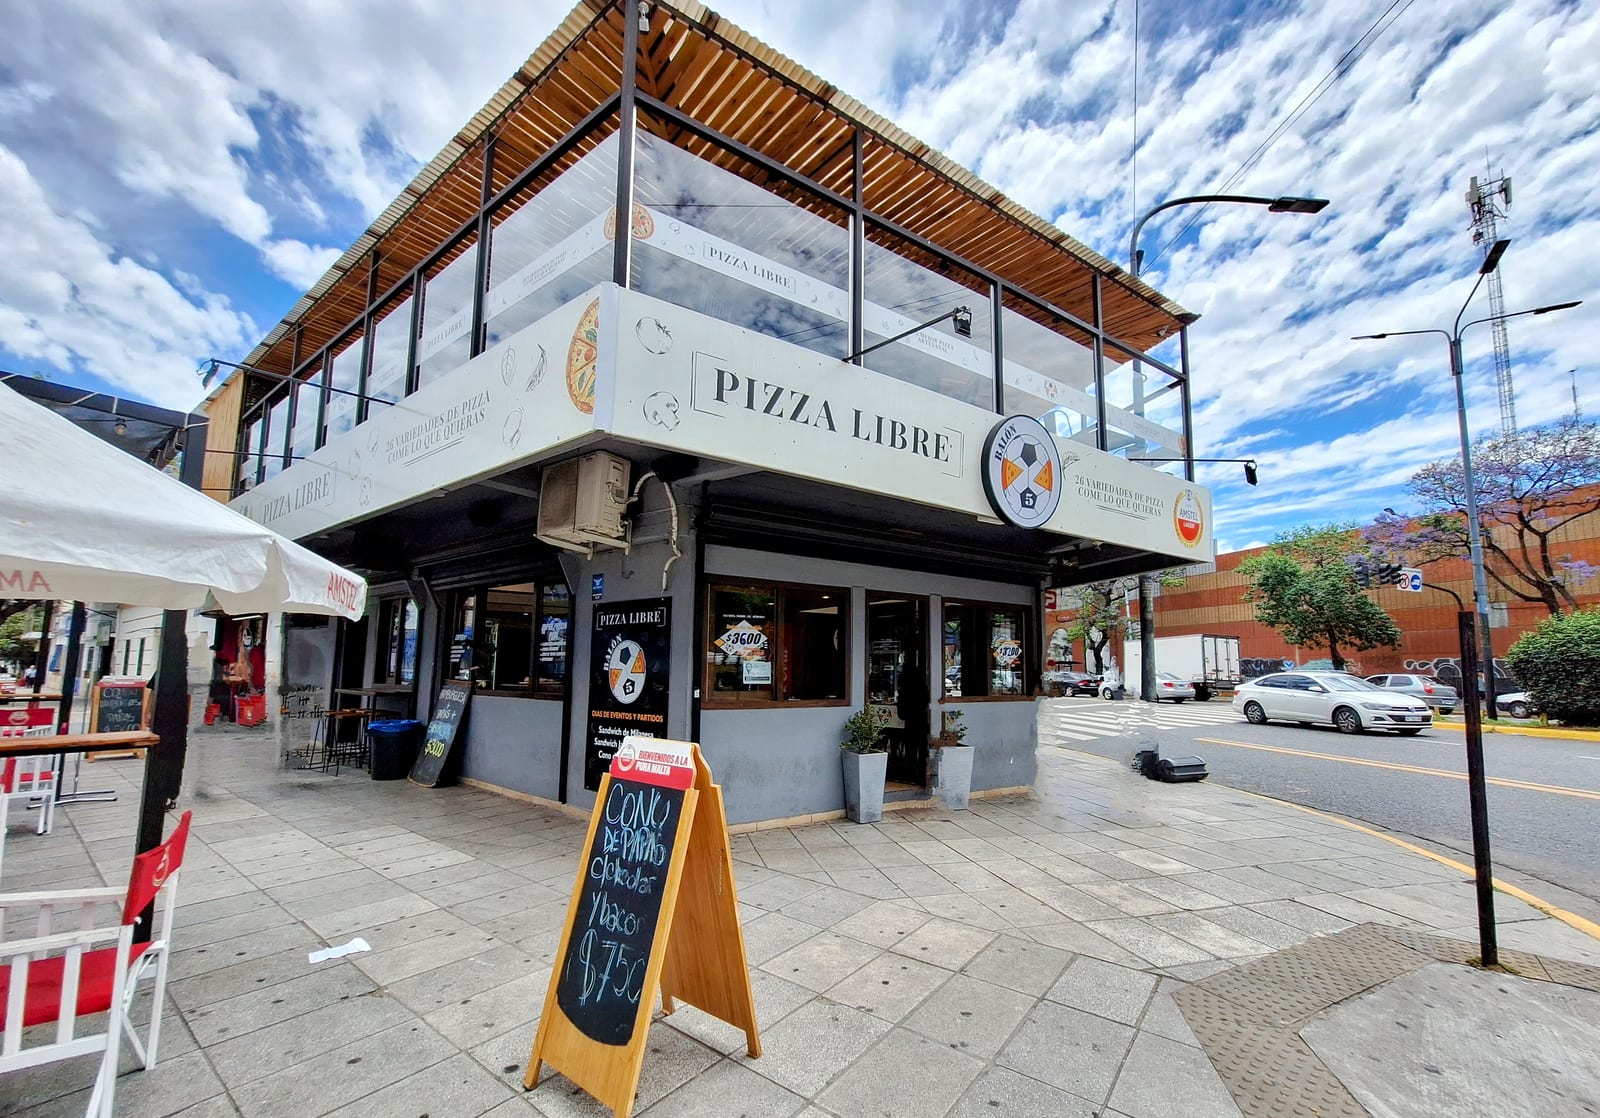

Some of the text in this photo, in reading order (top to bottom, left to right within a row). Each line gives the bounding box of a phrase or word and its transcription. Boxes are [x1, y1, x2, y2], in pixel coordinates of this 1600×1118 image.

[709, 247, 791, 288] PIZZA LIBRE
[395, 413, 445, 446] VARIEDADES
[447, 405, 460, 422] DE
[462, 389, 490, 415] PIZZA
[713, 367, 950, 463] PIZZA LIBRE
[387, 408, 486, 464] COME LO QUE QUIERAS
[994, 423, 1017, 461] BALÓN
[262, 473, 331, 524] PIZZA LIBRE
[1025, 493, 1034, 506] 5
[1075, 474, 1164, 508] 26 VARIEDADES DE PIZZA
[1078, 486, 1162, 517] COME LO QUE QUIERAS
[1179, 507, 1199, 522] AMSTEL
[327, 571, 357, 611] AMSTEL
[600, 610, 661, 626] PIZZA LIBRE
[726, 632, 762, 646] $3600
[625, 681, 633, 693] 5
[603, 711, 610, 719] DE
[610, 711, 633, 720] EVENTOS
[637, 713, 664, 723] PARTIDOS
[598, 725, 622, 736] Sandwich
[623, 727, 630, 737] de
[594, 737, 618, 749] Sandwich
[598, 750, 612, 760] Cono
[638, 750, 674, 764] BIENVENIDOS
[680, 757, 689, 767] LA
[602, 826, 620, 855] DE
